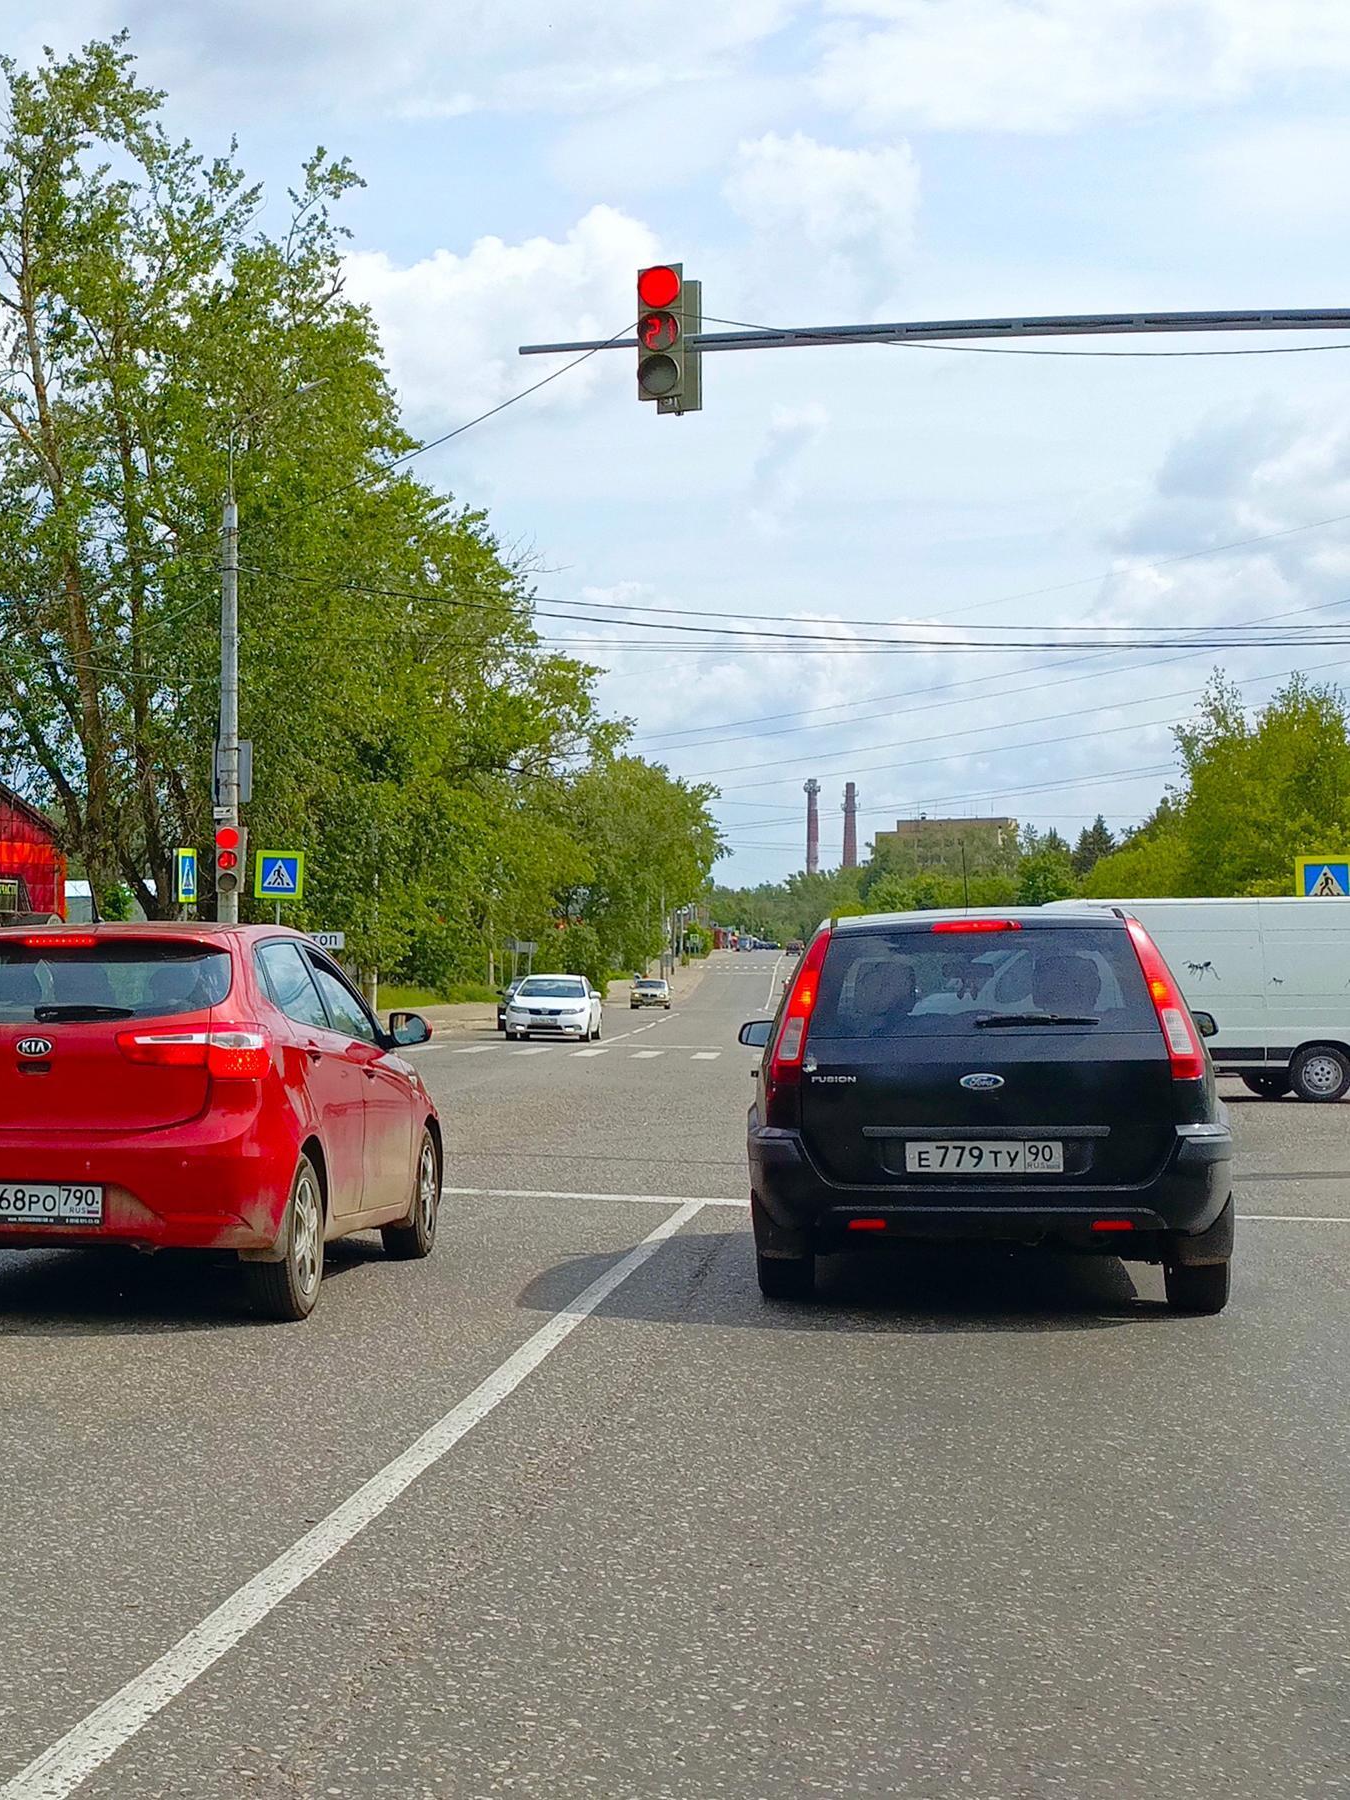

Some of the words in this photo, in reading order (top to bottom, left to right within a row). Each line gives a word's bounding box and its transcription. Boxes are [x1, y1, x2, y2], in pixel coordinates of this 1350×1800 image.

[21, 1042, 46, 1053] KIA
[811, 1076, 857, 1084] FUSION
[1027, 1144, 1054, 1162] 90
[61, 1188, 96, 1207] 790
[68, 1206, 87, 1214] RUS
